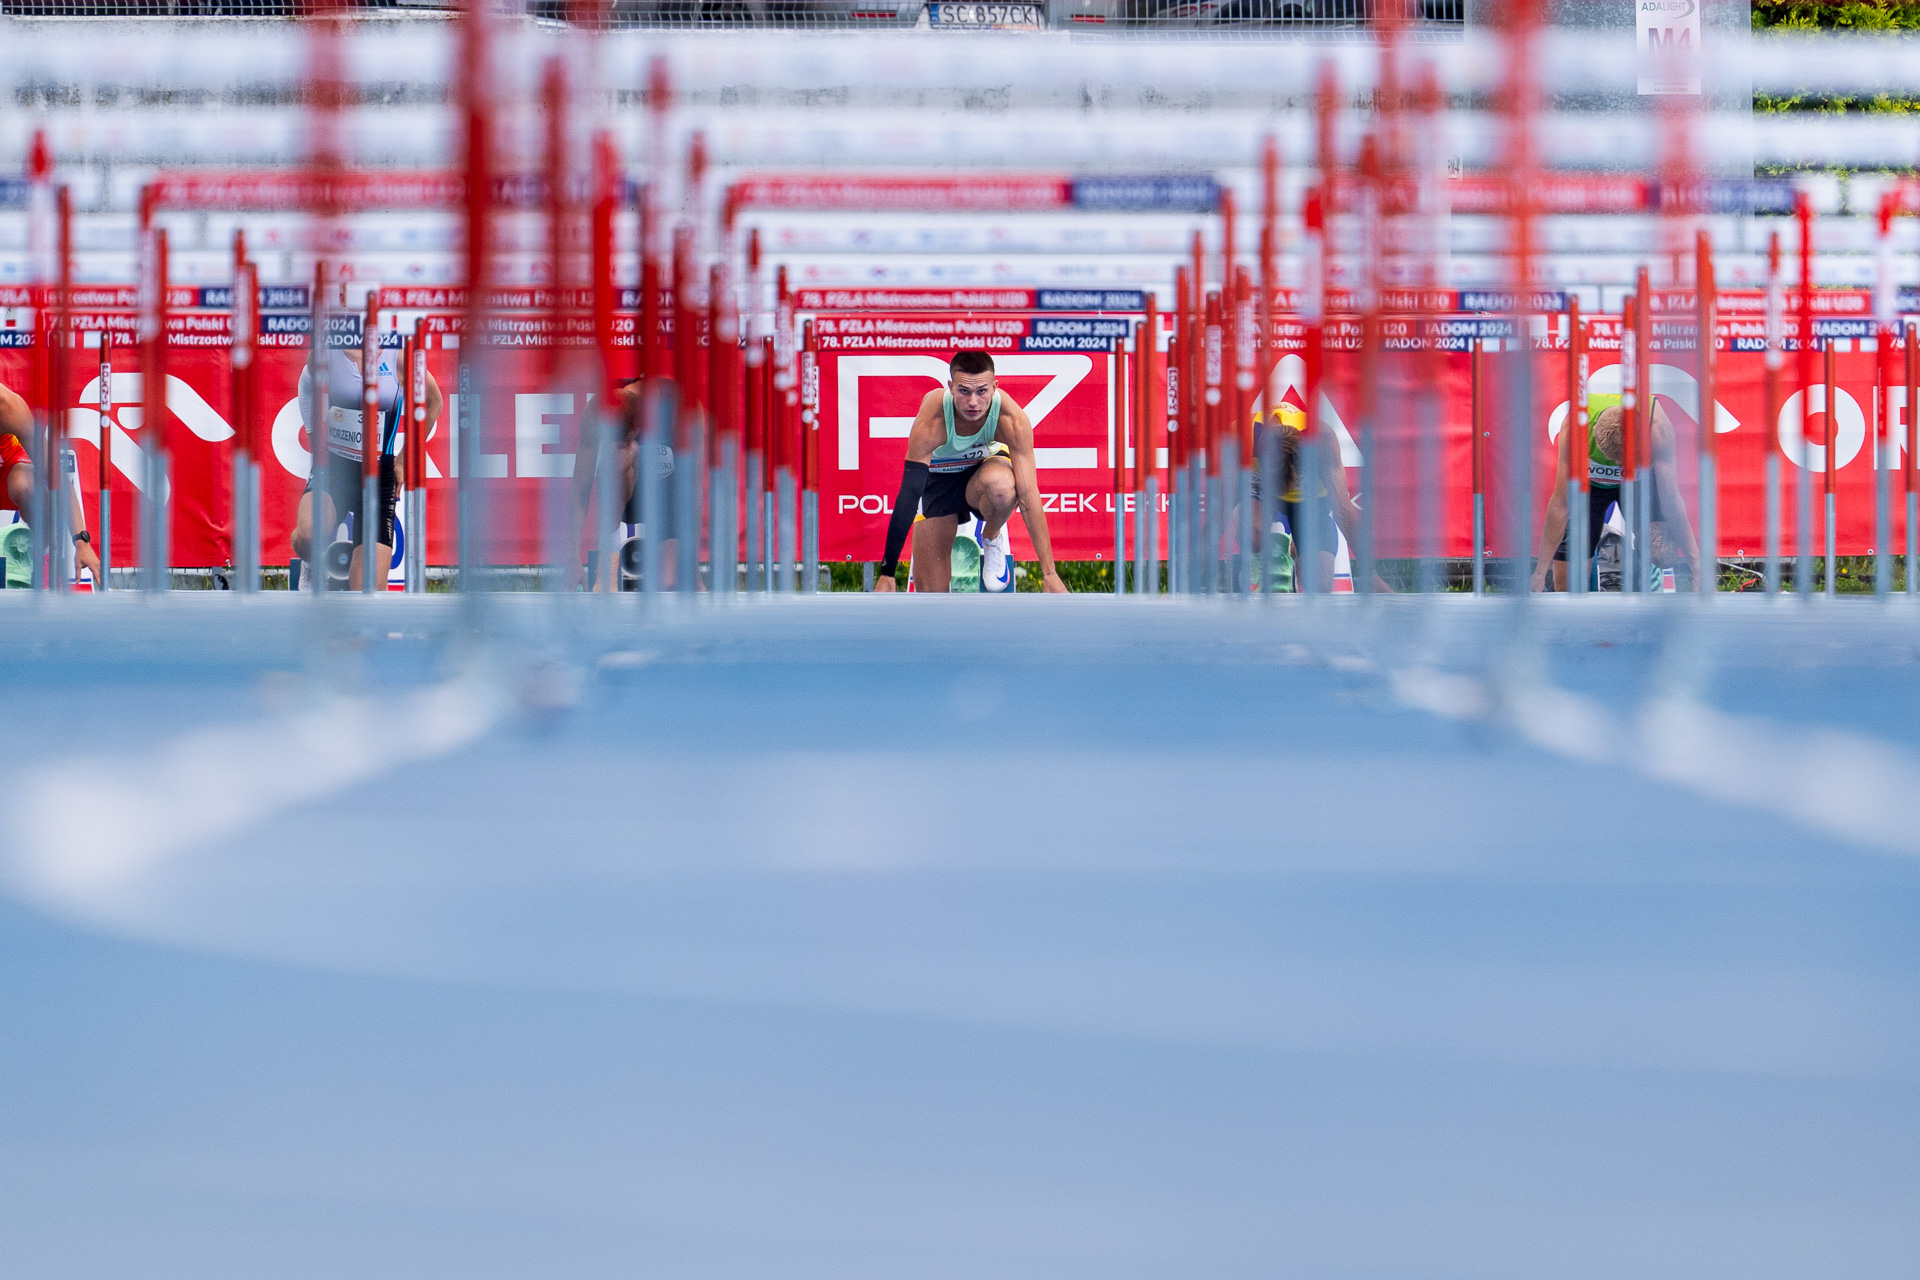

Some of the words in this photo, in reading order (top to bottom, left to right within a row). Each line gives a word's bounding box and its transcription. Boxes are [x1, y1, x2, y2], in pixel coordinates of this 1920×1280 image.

[1641, 2, 1687, 11] ADALIGHT
[943, 6, 968, 23] SC
[1648, 27, 1693, 54] M4
[186, 317, 223, 331] Polski
[839, 320, 875, 333] PZLA
[876, 320, 954, 334] Mistrzostwa
[954, 320, 994, 334] Polski
[995, 320, 1024, 334] U20
[1036, 321, 1092, 335] RADOM
[1093, 321, 1126, 335] 2024
[167, 332, 235, 346] Mistrzostw
[278, 333, 304, 346] U20
[324, 334, 364, 347] ADOM
[492, 334, 523, 347] PZLA
[822, 336, 841, 348] 78.
[843, 336, 876, 348] PZLA
[876, 336, 948, 348] Mistrzostwa
[950, 336, 985, 348] Polski
[987, 336, 1012, 348] U20
[1025, 337, 1075, 349] RADOM
[1077, 337, 1108, 349] 2024
[1434, 337, 1465, 350] 2024
[1535, 337, 1552, 349] 78.
[962, 450, 984, 460] 172
